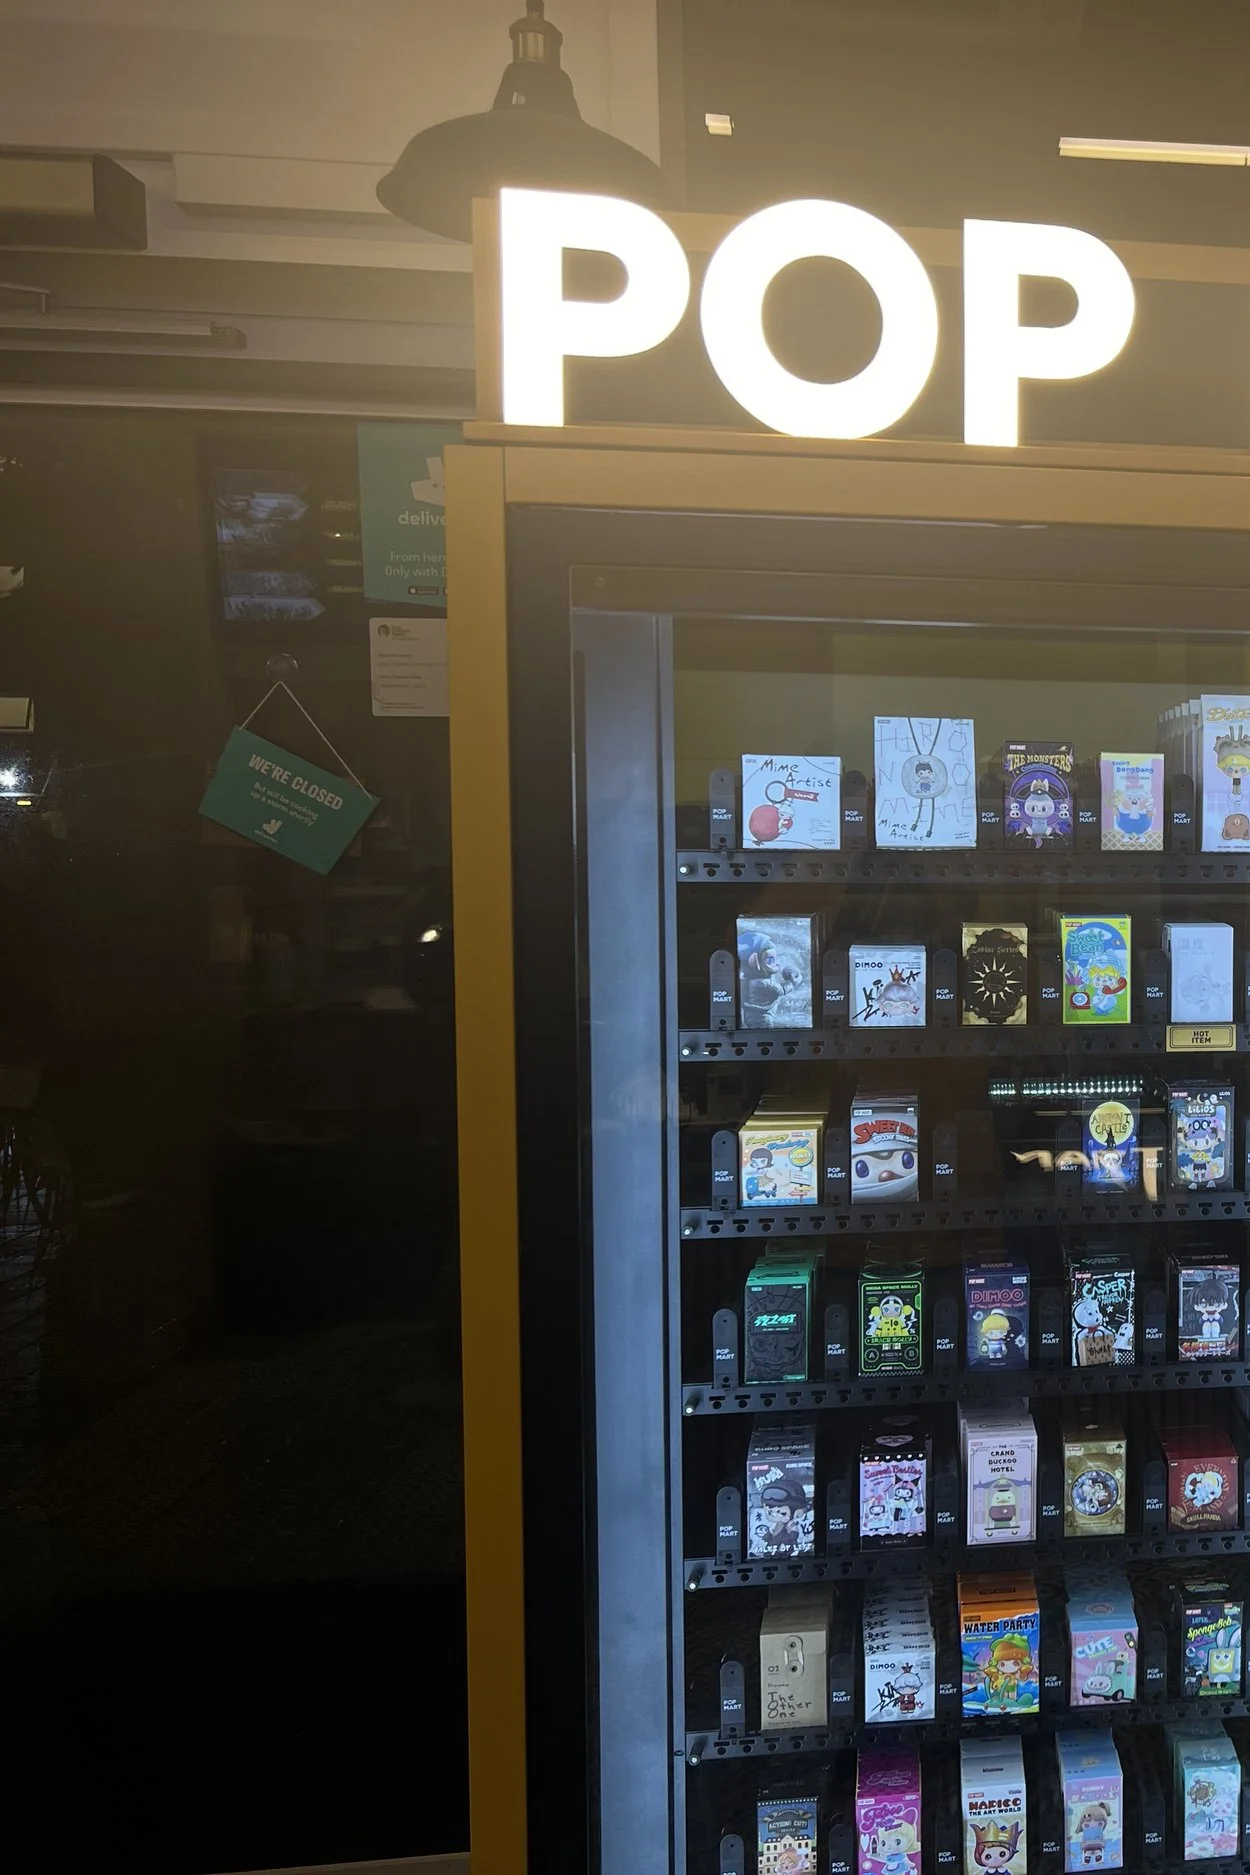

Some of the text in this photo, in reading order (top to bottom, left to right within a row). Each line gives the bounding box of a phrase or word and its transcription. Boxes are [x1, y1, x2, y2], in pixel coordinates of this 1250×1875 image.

[500, 187, 1136, 448] POP
[390, 551, 420, 562] From
[385, 565, 410, 579] Only
[413, 566, 438, 577] with
[761, 758, 799, 773] Mime
[1007, 753, 1072, 773] THE MONSTERS
[249, 753, 344, 811] WE'RE CLOSED
[785, 772, 832, 788] Artist
[879, 819, 907, 831] Mime
[889, 830, 924, 842] Artist
[1067, 931, 1104, 944] Sweet
[1070, 941, 1104, 956] Bean
[853, 1120, 899, 1144] SWEET
[971, 1288, 1024, 1303] DIMOO
[1083, 1279, 1127, 1299] CASPER
[1186, 1513, 1221, 1523] SKULLPANDA
[964, 1619, 1037, 1634] WATER PARTY
[1187, 1616, 1232, 1641] SpongeBob
[767, 1664, 780, 1673] 01
[767, 1691, 795, 1702] The
[767, 1700, 813, 1711] Other
[767, 1709, 796, 1719] One
